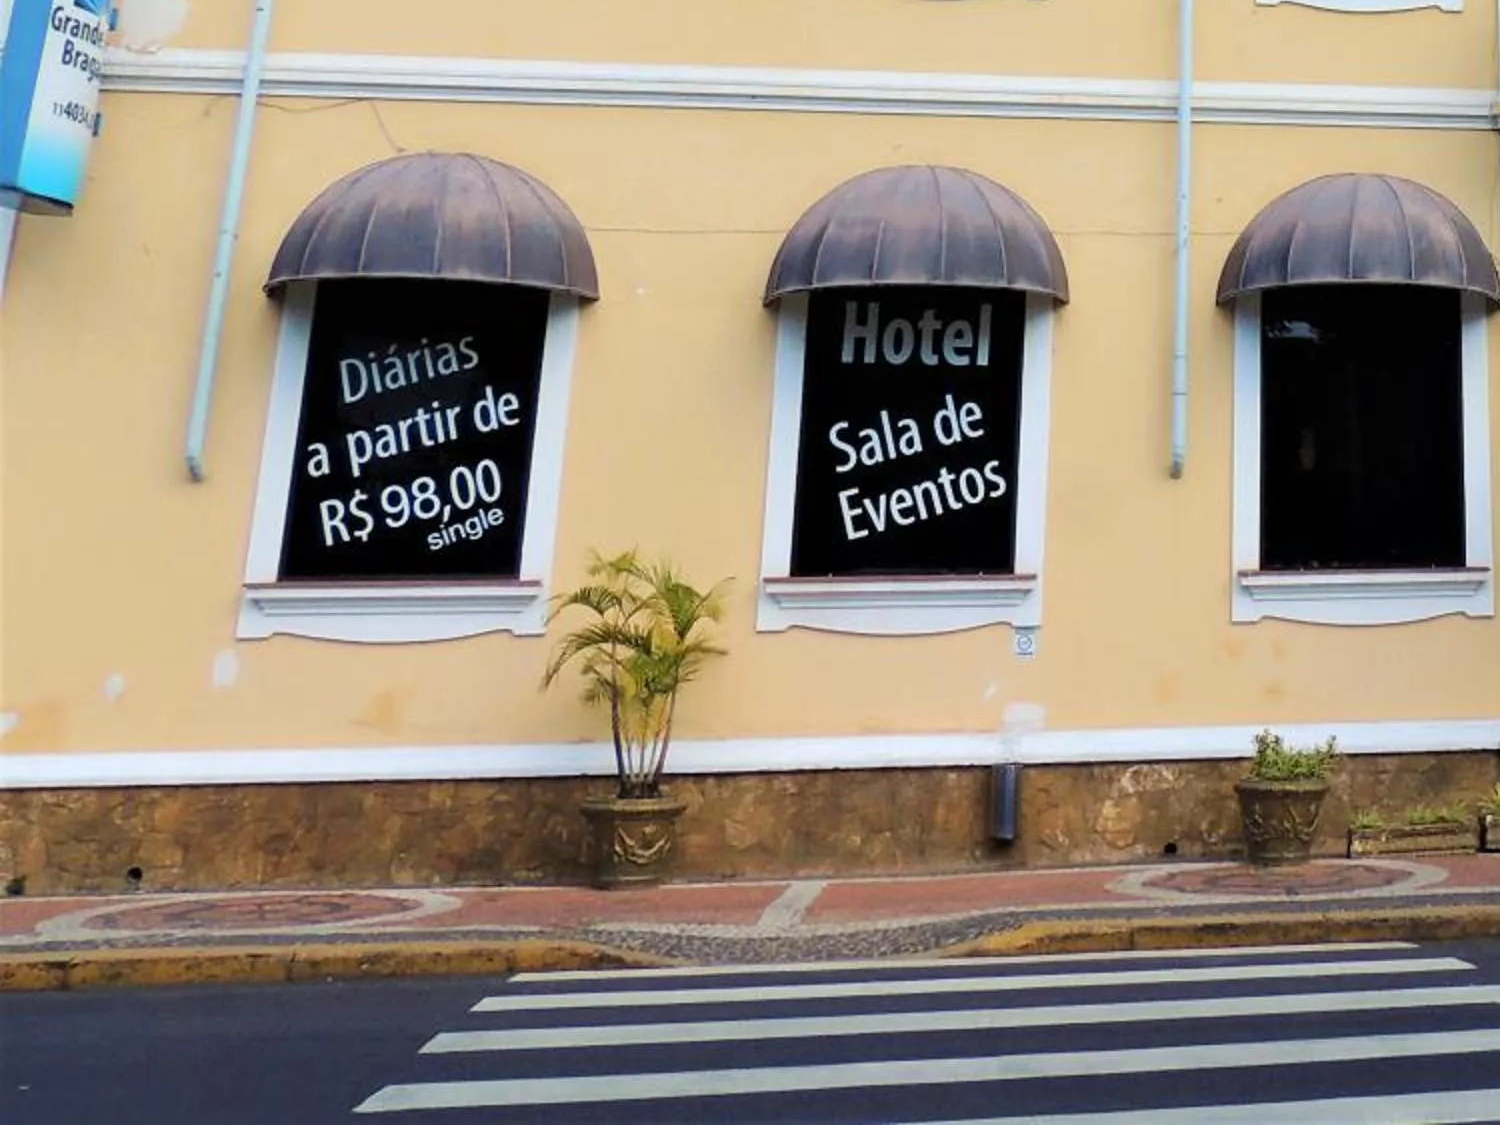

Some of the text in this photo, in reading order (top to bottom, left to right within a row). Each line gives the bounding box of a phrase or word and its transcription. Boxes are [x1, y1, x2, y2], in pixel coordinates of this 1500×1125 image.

[340, 336, 480, 404] Diárias
[840, 301, 993, 366] Hotel
[307, 385, 520, 477] a partir de
[828, 394, 985, 473] Sala de
[319, 459, 502, 546] R$ 98,00
[427, 507, 504, 550] single
[838, 459, 1007, 540] Eventos
